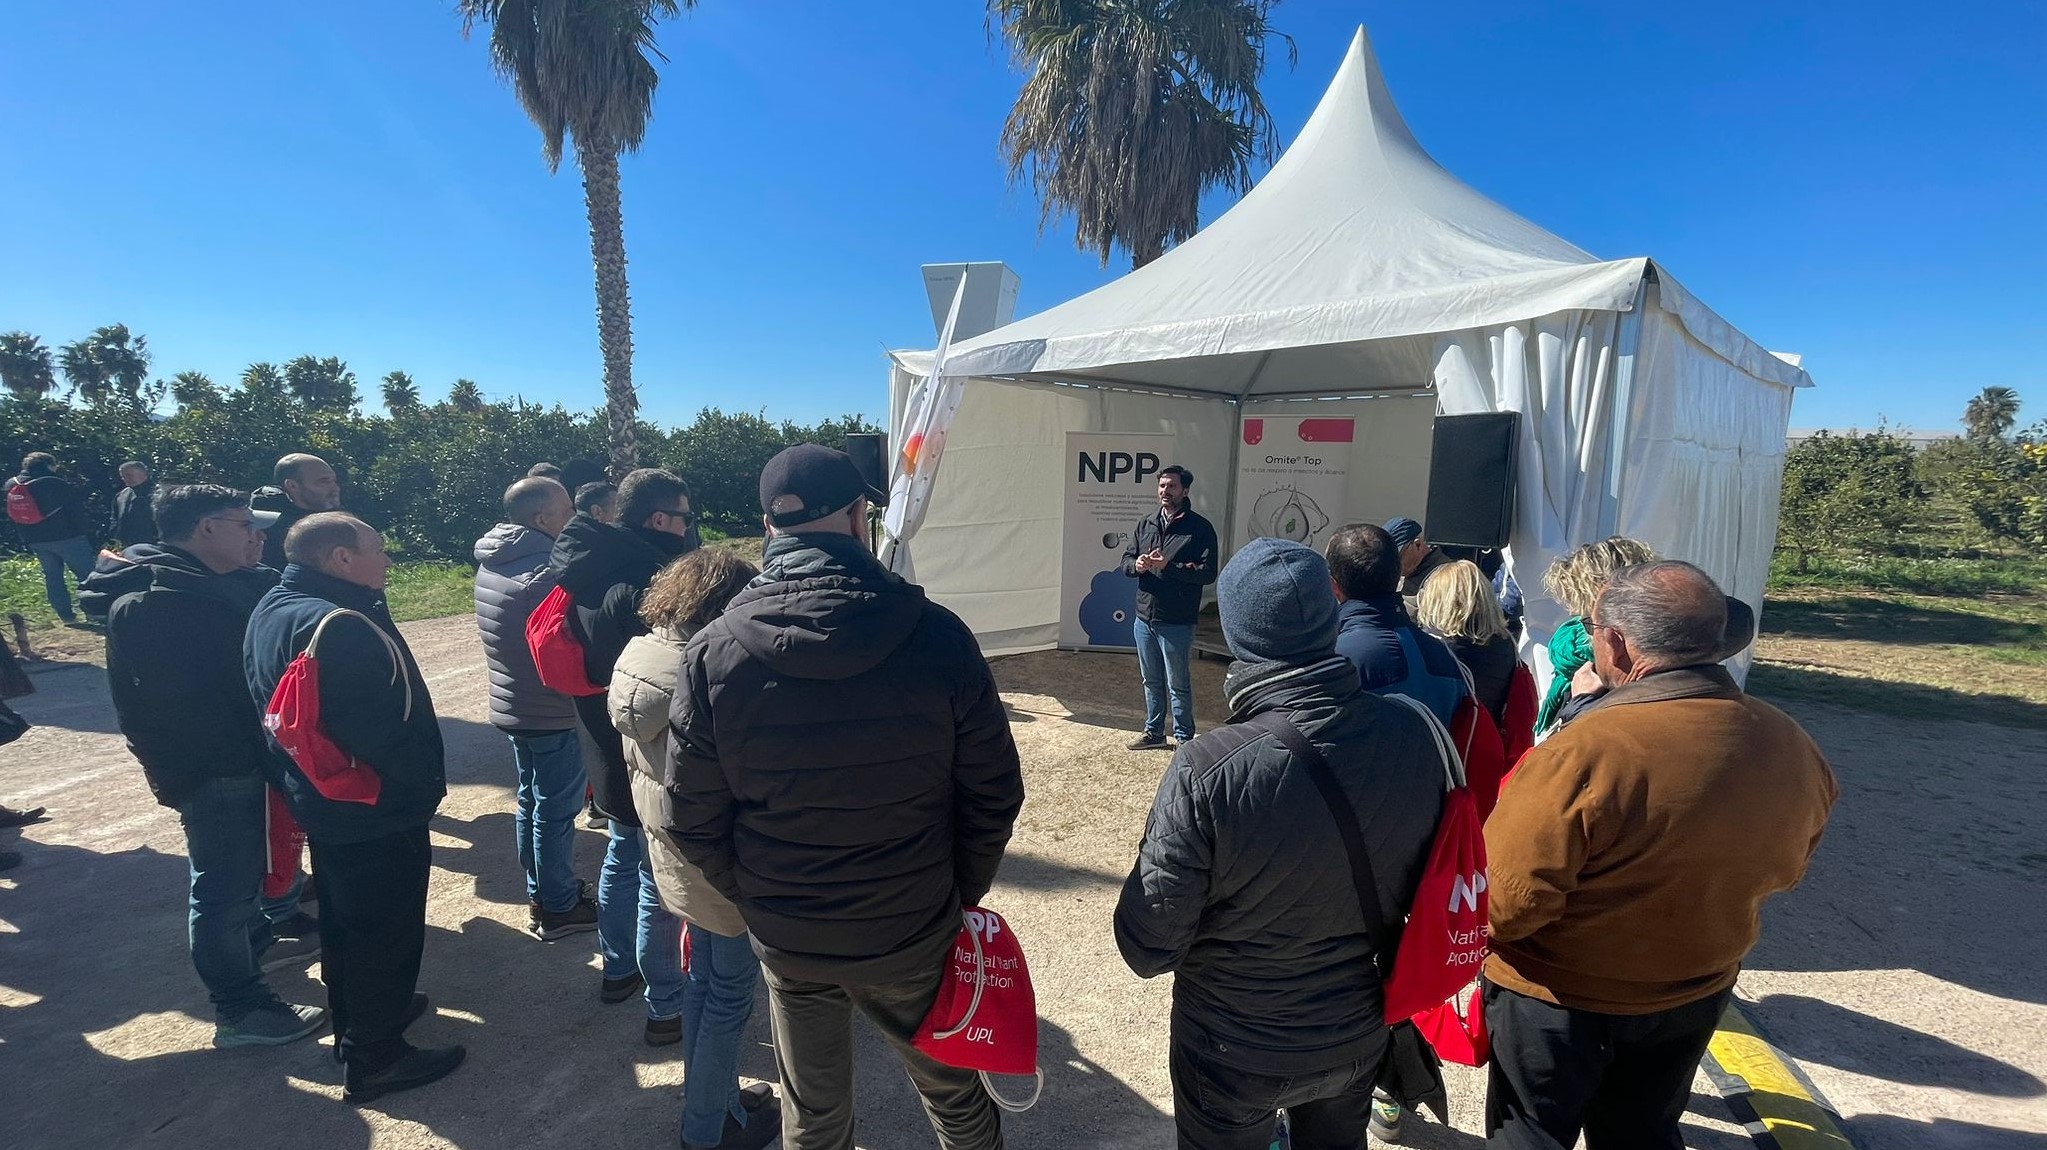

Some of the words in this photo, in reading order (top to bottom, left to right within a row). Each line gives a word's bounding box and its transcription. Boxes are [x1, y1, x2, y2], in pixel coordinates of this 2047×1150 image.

[1078, 451, 1160, 483] NPP
[1304, 456, 1322, 466] Top
[1448, 868, 1488, 913] NP
[962, 911, 1001, 944] PP
[954, 945, 996, 969] Natal
[966, 1026, 994, 1045] UPL
